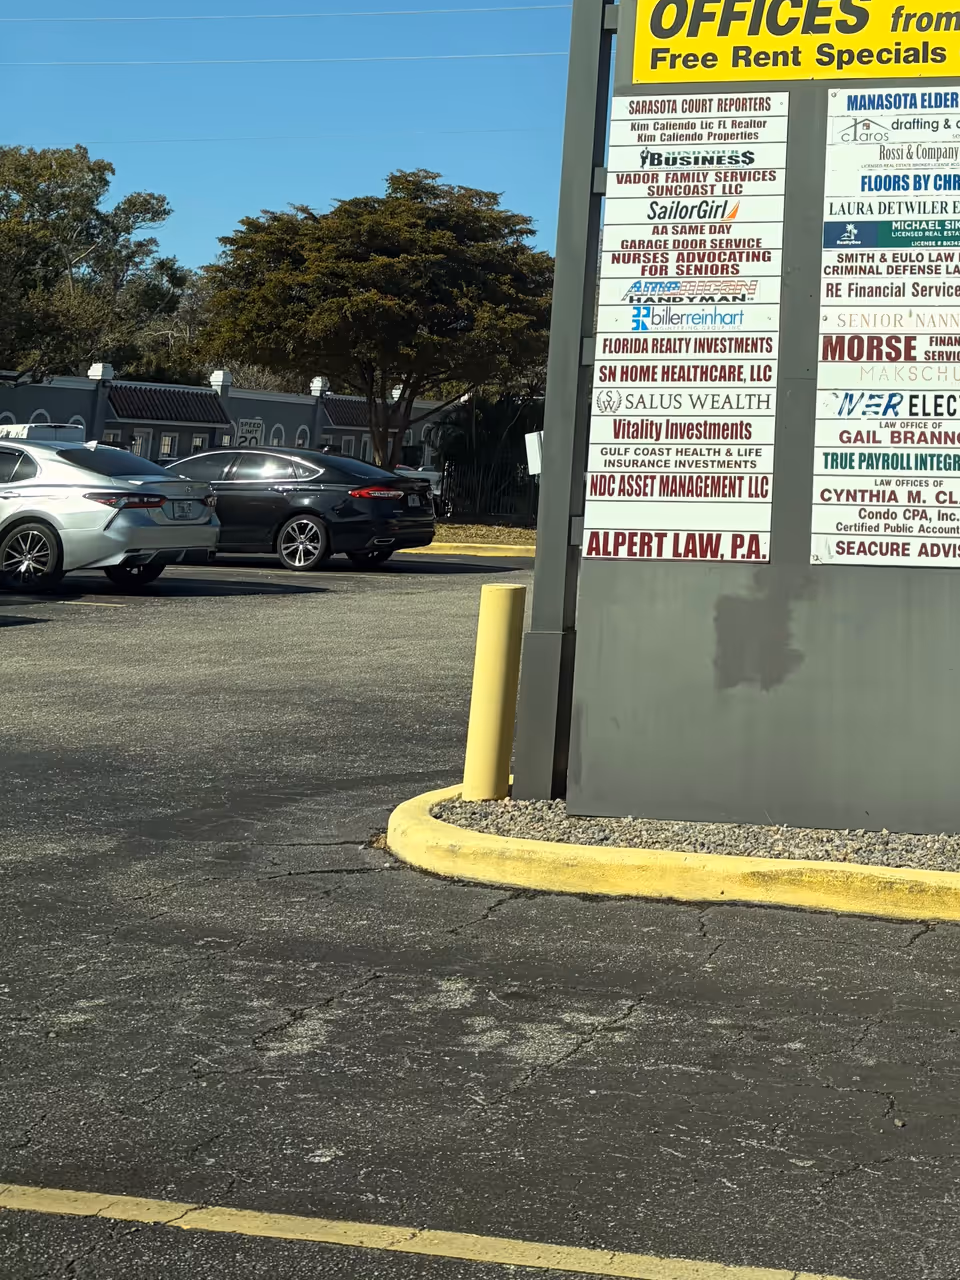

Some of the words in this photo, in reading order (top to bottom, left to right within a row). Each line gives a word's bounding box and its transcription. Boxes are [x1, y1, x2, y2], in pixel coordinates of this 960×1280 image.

[651, 47, 719, 70] Free
[733, 44, 801, 67] Rent
[816, 42, 946, 67] Specials
[629, 100, 677, 115] SARASOTA
[681, 99, 713, 113] COURT
[717, 97, 771, 112] REPORTERS
[847, 93, 918, 111] MANASOTA
[921, 93, 959, 108] ELDER
[891, 118, 939, 132] drafting
[943, 119, 951, 129] &
[879, 145, 903, 160] Rossi
[906, 146, 913, 159] &
[916, 144, 959, 162] Company
[861, 175, 909, 191] FLOORS
[913, 175, 930, 190] BY
[647, 200, 727, 220] SailorGirl
[829, 202, 874, 215] LAURA
[878, 201, 948, 214] DETWILER
[892, 221, 941, 230] MICHAEL
[611, 252, 669, 264] NURSES
[676, 251, 771, 263] ADVOCATING
[837, 254, 875, 263] SMITH
[879, 253, 887, 263] &
[892, 253, 924, 262] EULO
[928, 253, 954, 262] LAW
[641, 265, 668, 276] FOR
[676, 264, 740, 275] SENIORS
[823, 266, 882, 275] CRIMINAL
[887, 265, 941, 275] DEFENSE
[837, 314, 903, 328] SENIOR
[602, 338, 648, 354] FLORIDA
[651, 338, 692, 354] REALTY
[693, 338, 773, 354] INVESTMENTS
[625, 394, 682, 410] SALUS
[688, 394, 771, 410] WEALTH
[613, 420, 663, 442] Vitality
[665, 420, 752, 440] Investments
[839, 430, 882, 444] GAIL
[823, 452, 855, 470] TRUE
[858, 453, 912, 471] PAYROLL
[590, 476, 616, 496] NDC
[618, 476, 656, 497] ASSET
[659, 476, 744, 498] MANAGEMENT
[748, 477, 768, 498] LLC
[859, 508, 898, 520] Condo
[903, 509, 932, 522] CPA,
[937, 509, 960, 521] Inc.
[836, 522, 880, 533] Certified
[884, 523, 914, 533] Public
[587, 532, 667, 557] ALPERT
[673, 534, 724, 560] LAW,
[731, 534, 767, 560] P.A.
[836, 541, 911, 556] SEACURE
